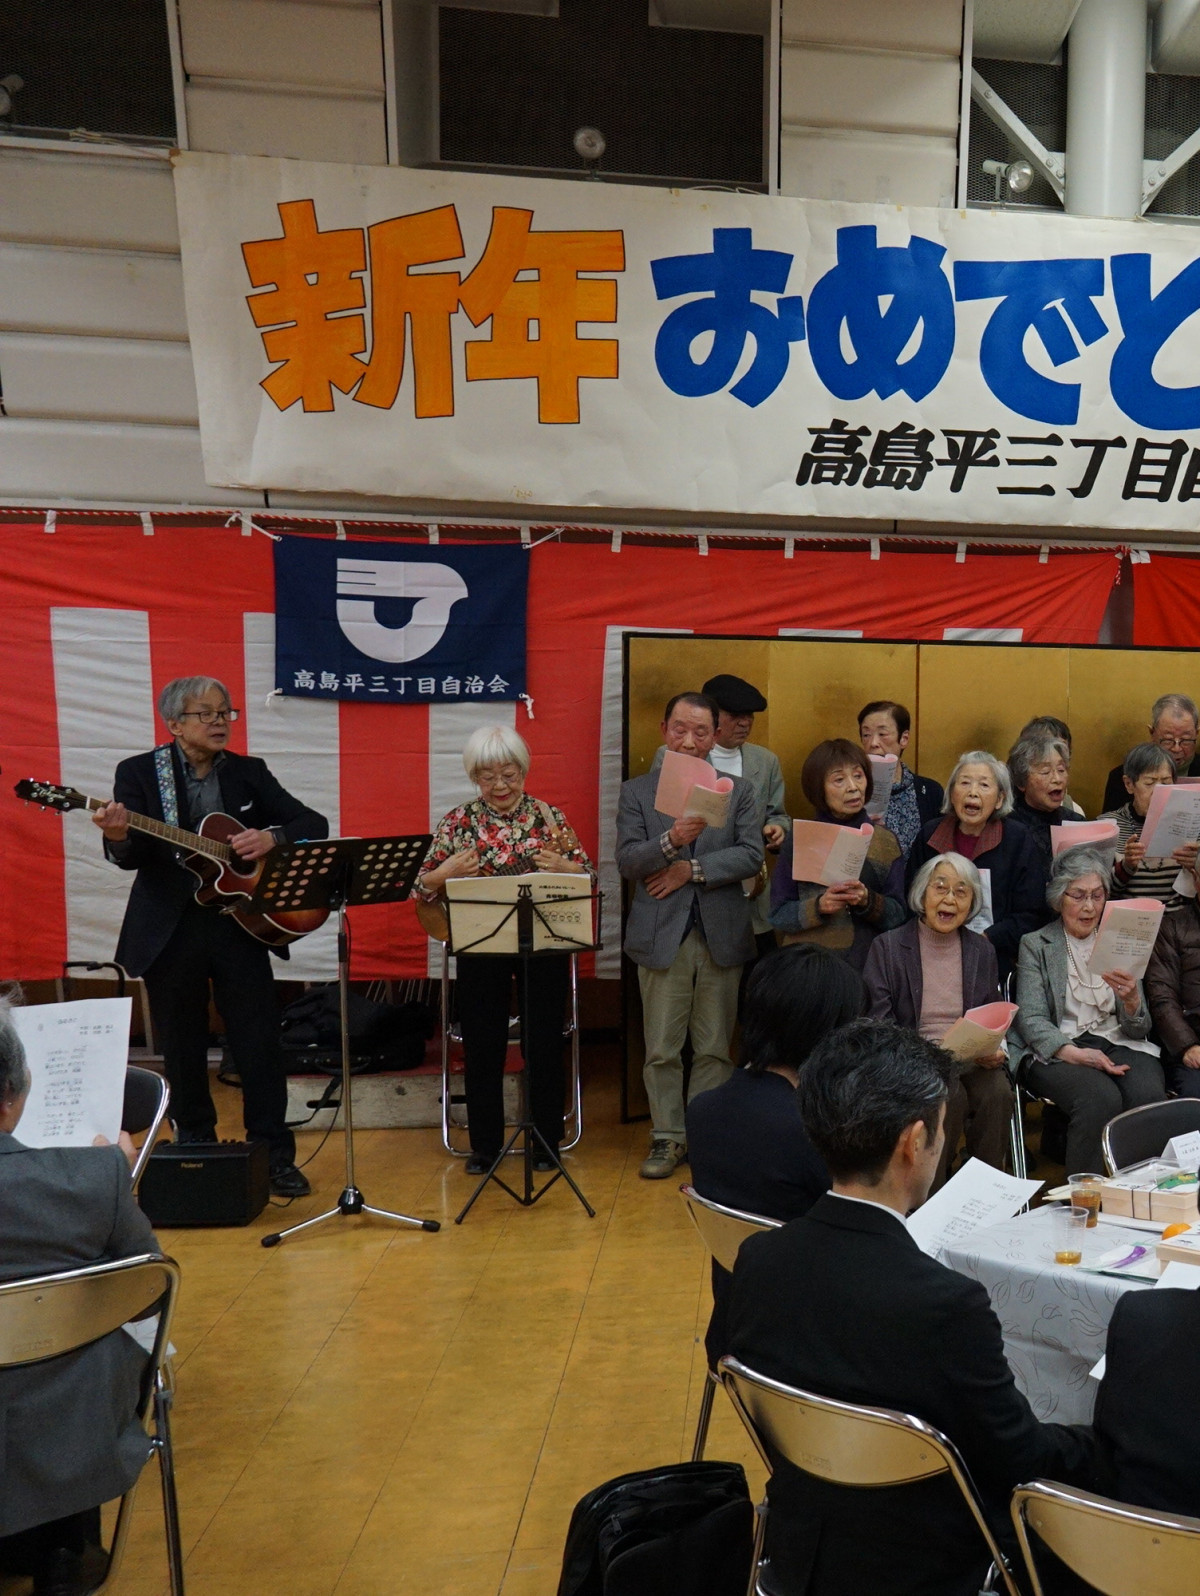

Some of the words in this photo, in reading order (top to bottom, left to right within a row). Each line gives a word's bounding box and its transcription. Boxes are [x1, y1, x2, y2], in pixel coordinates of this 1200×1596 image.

[293, 669, 511, 696] 高島平三丁目自治会
